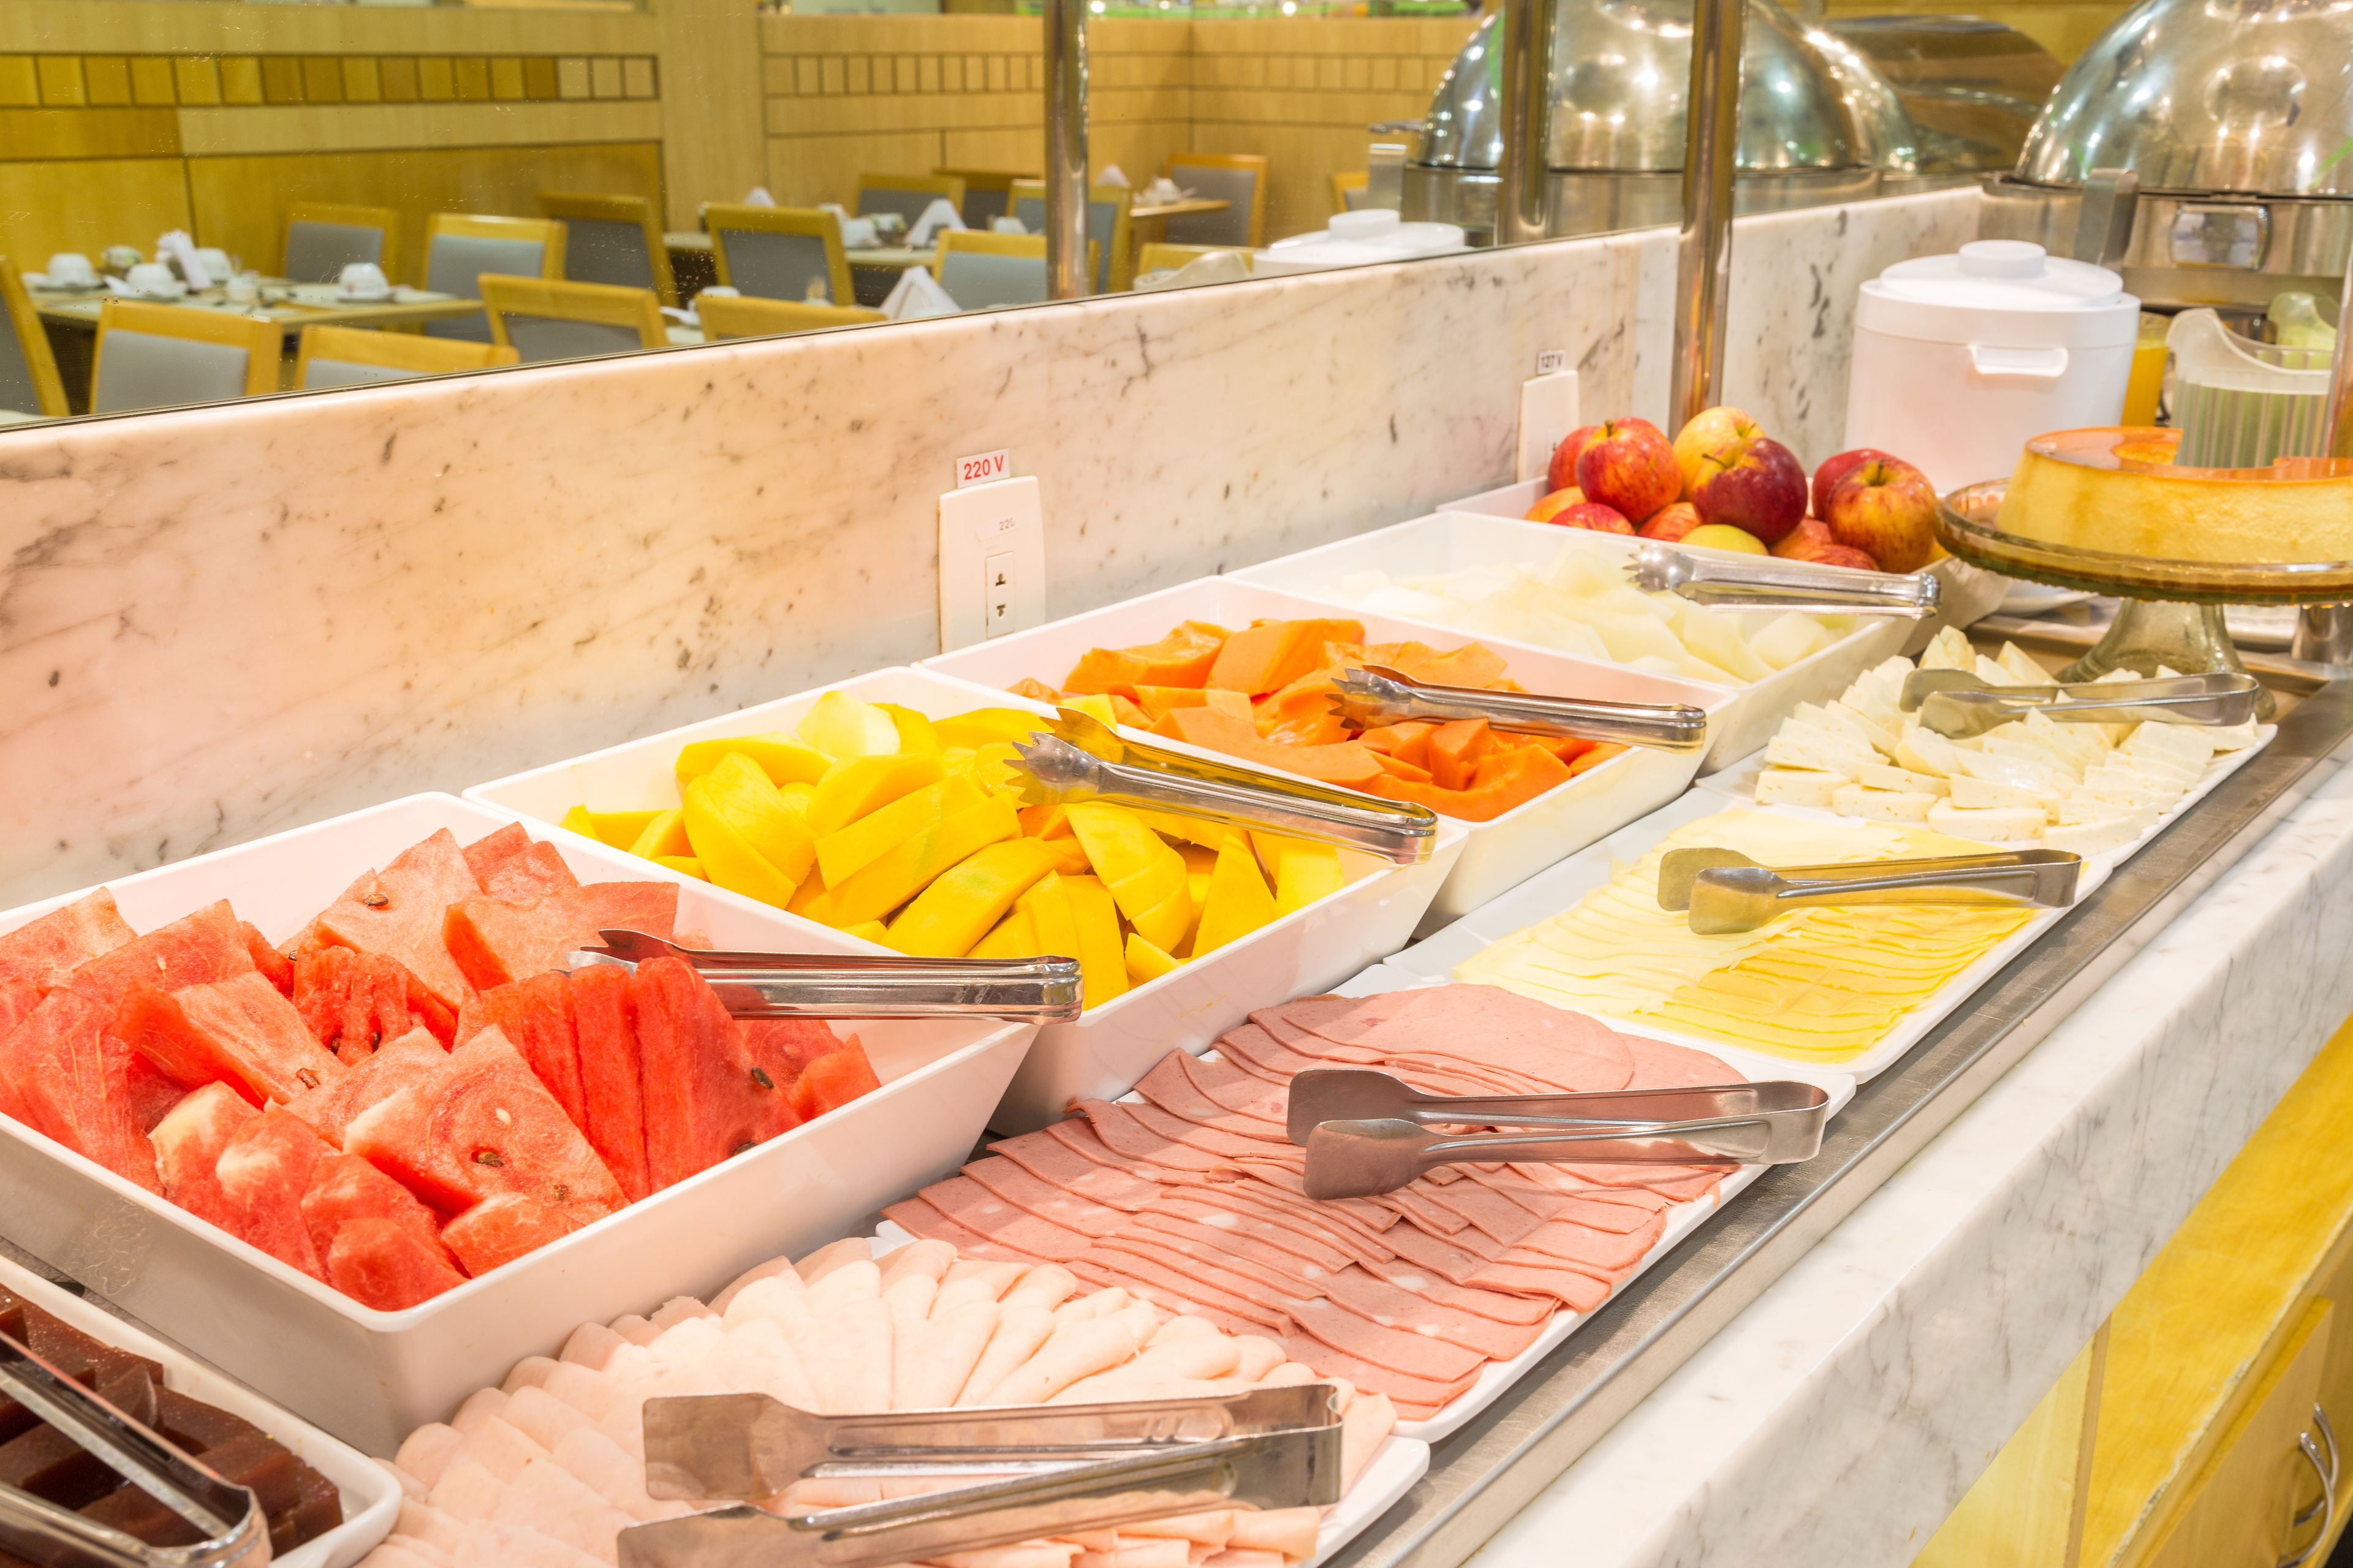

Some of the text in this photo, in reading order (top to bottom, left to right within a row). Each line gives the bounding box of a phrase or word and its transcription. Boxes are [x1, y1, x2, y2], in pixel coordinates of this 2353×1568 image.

[963, 455, 1004, 480] 220 V
[999, 517, 1015, 530] 220
